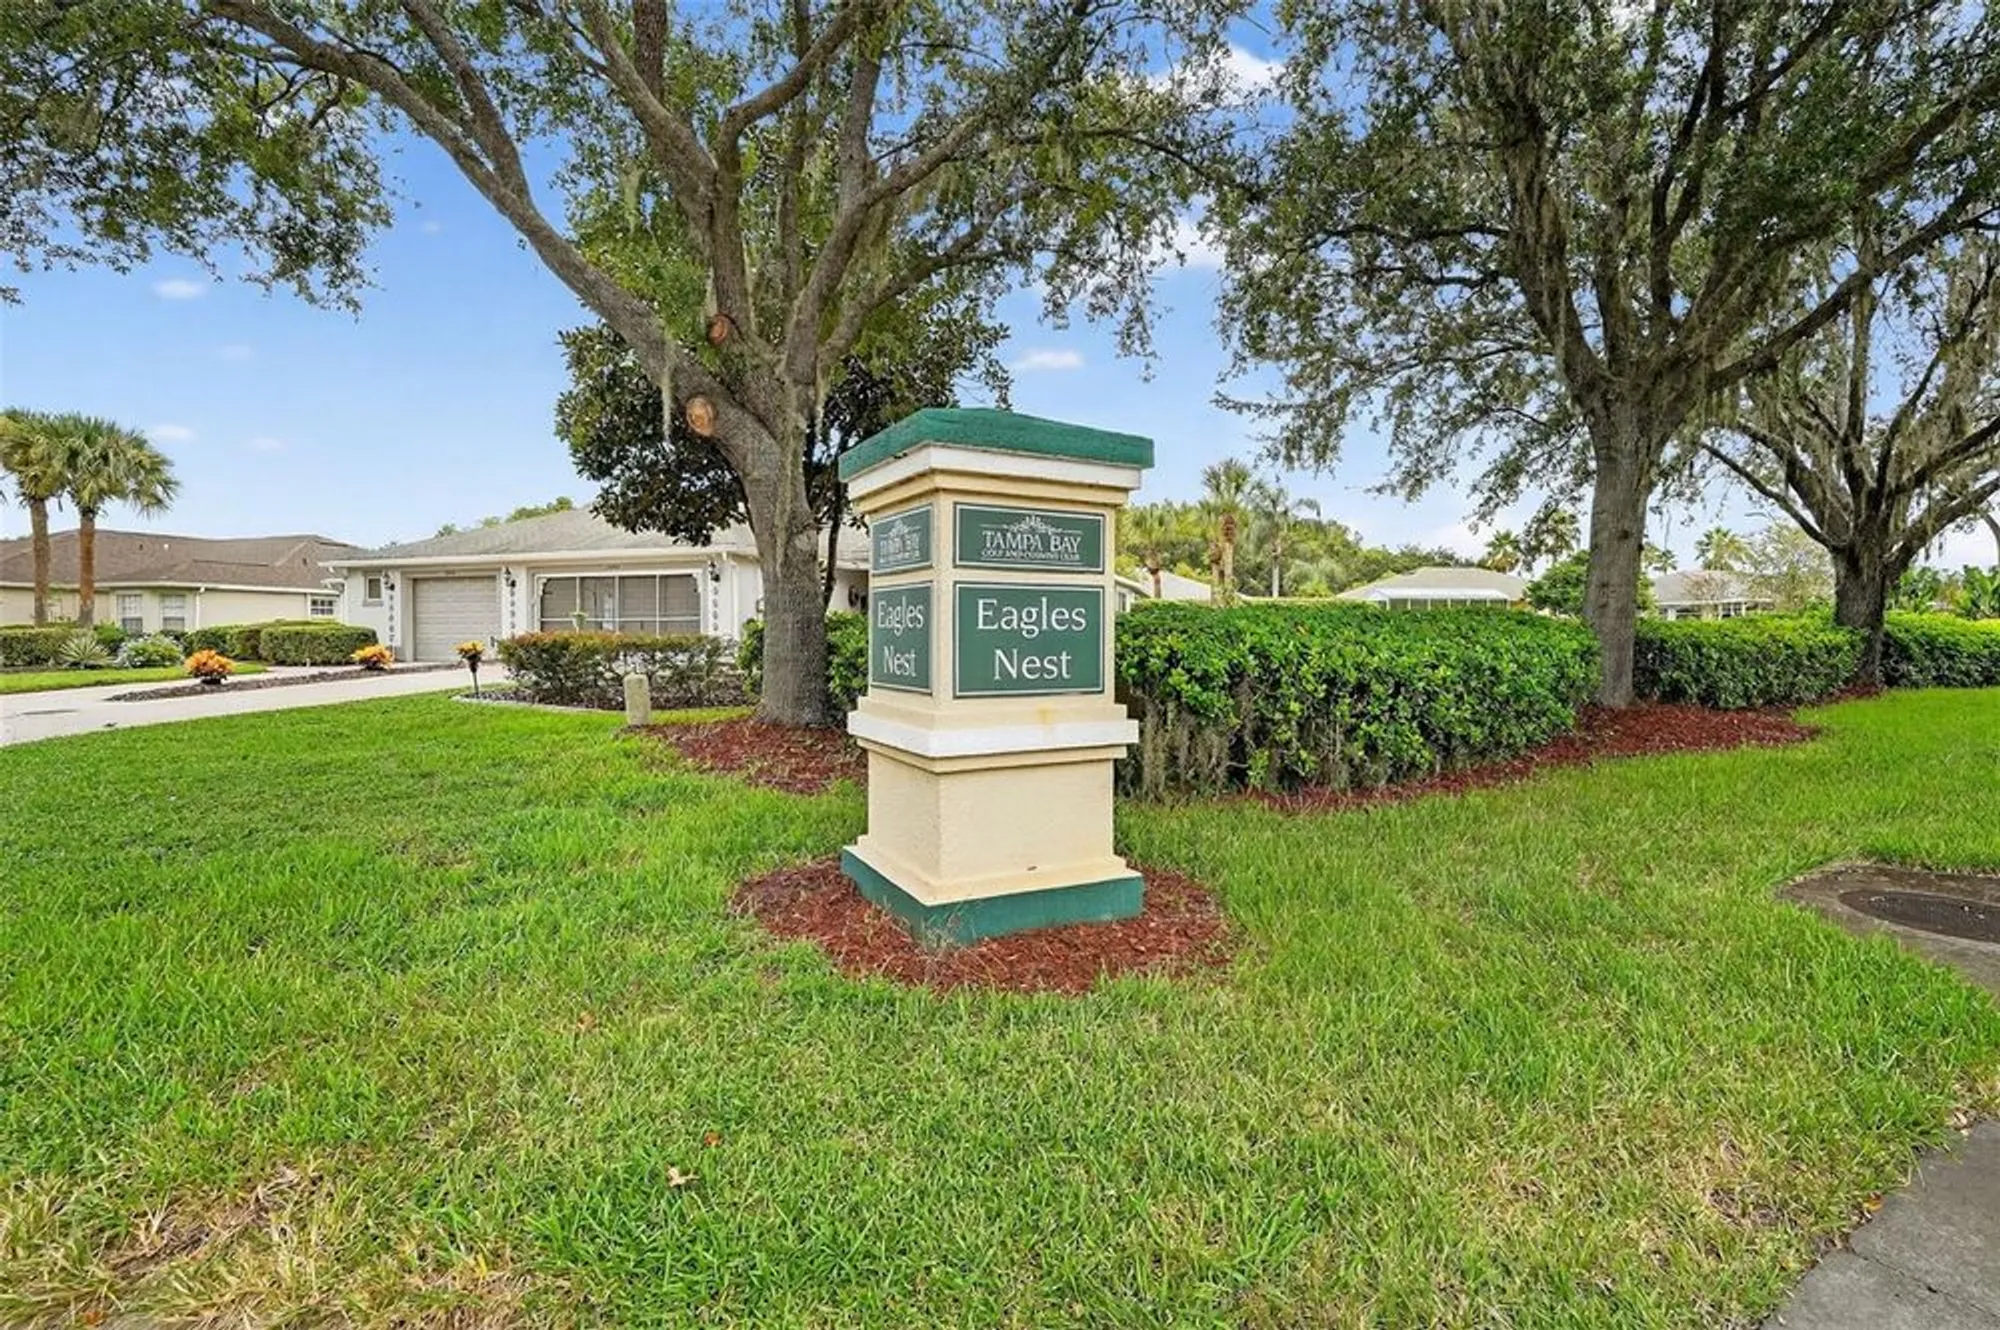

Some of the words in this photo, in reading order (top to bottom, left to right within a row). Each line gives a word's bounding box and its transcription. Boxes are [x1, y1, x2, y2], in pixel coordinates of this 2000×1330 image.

[982, 530, 1043, 552] TAMPA
[1050, 535, 1081, 553] BAY
[877, 595, 924, 637] Eagles
[976, 596, 1087, 639] Eagles
[883, 645, 917, 677] Nest
[993, 648, 1072, 681] Nest
